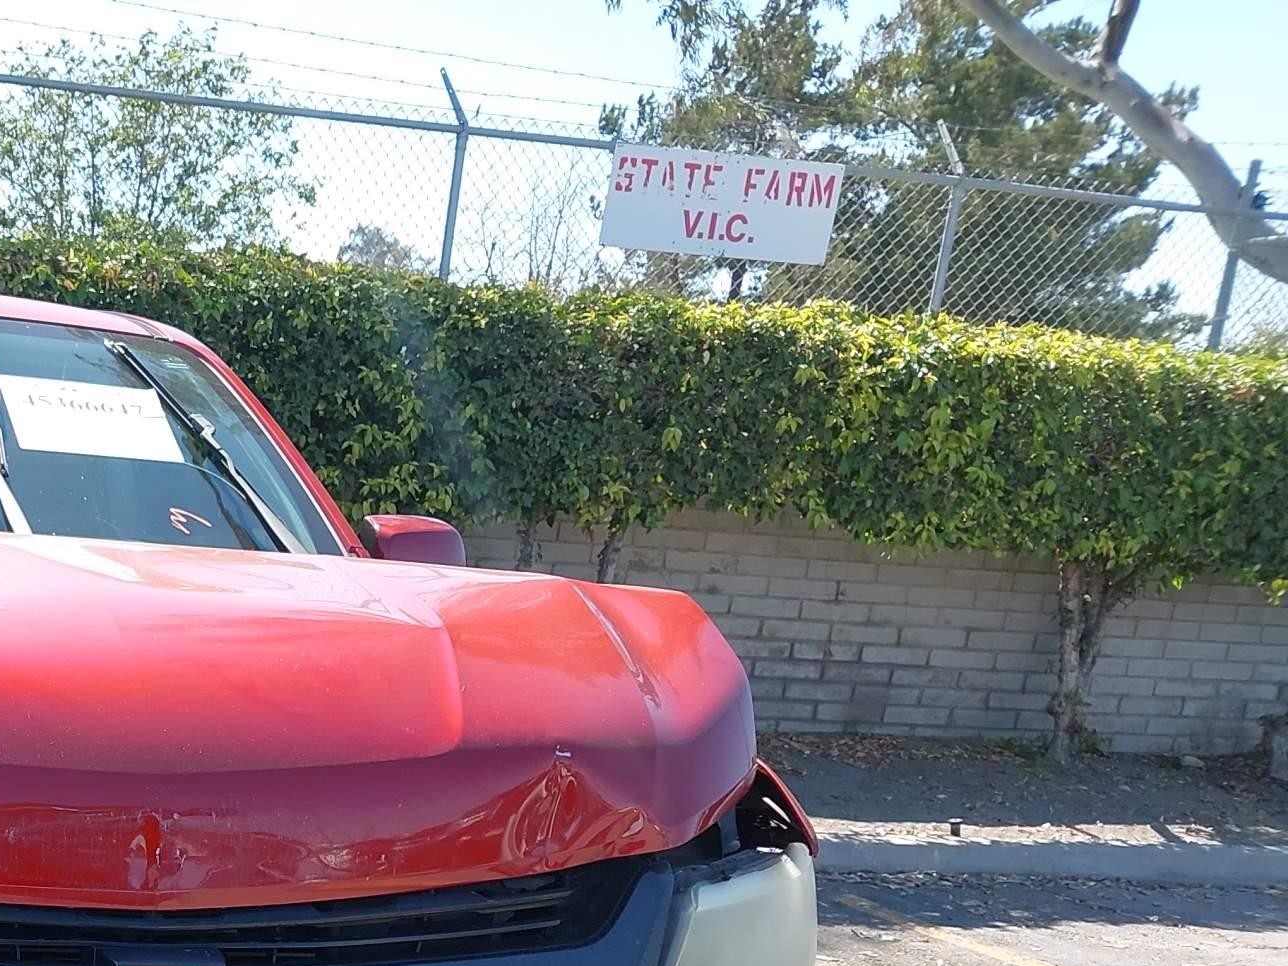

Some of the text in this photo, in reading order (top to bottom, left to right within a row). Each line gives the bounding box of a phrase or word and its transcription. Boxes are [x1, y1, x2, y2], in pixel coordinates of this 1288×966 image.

[615, 156, 836, 209] STATE FARM
[682, 209, 755, 243] V.I.C.
